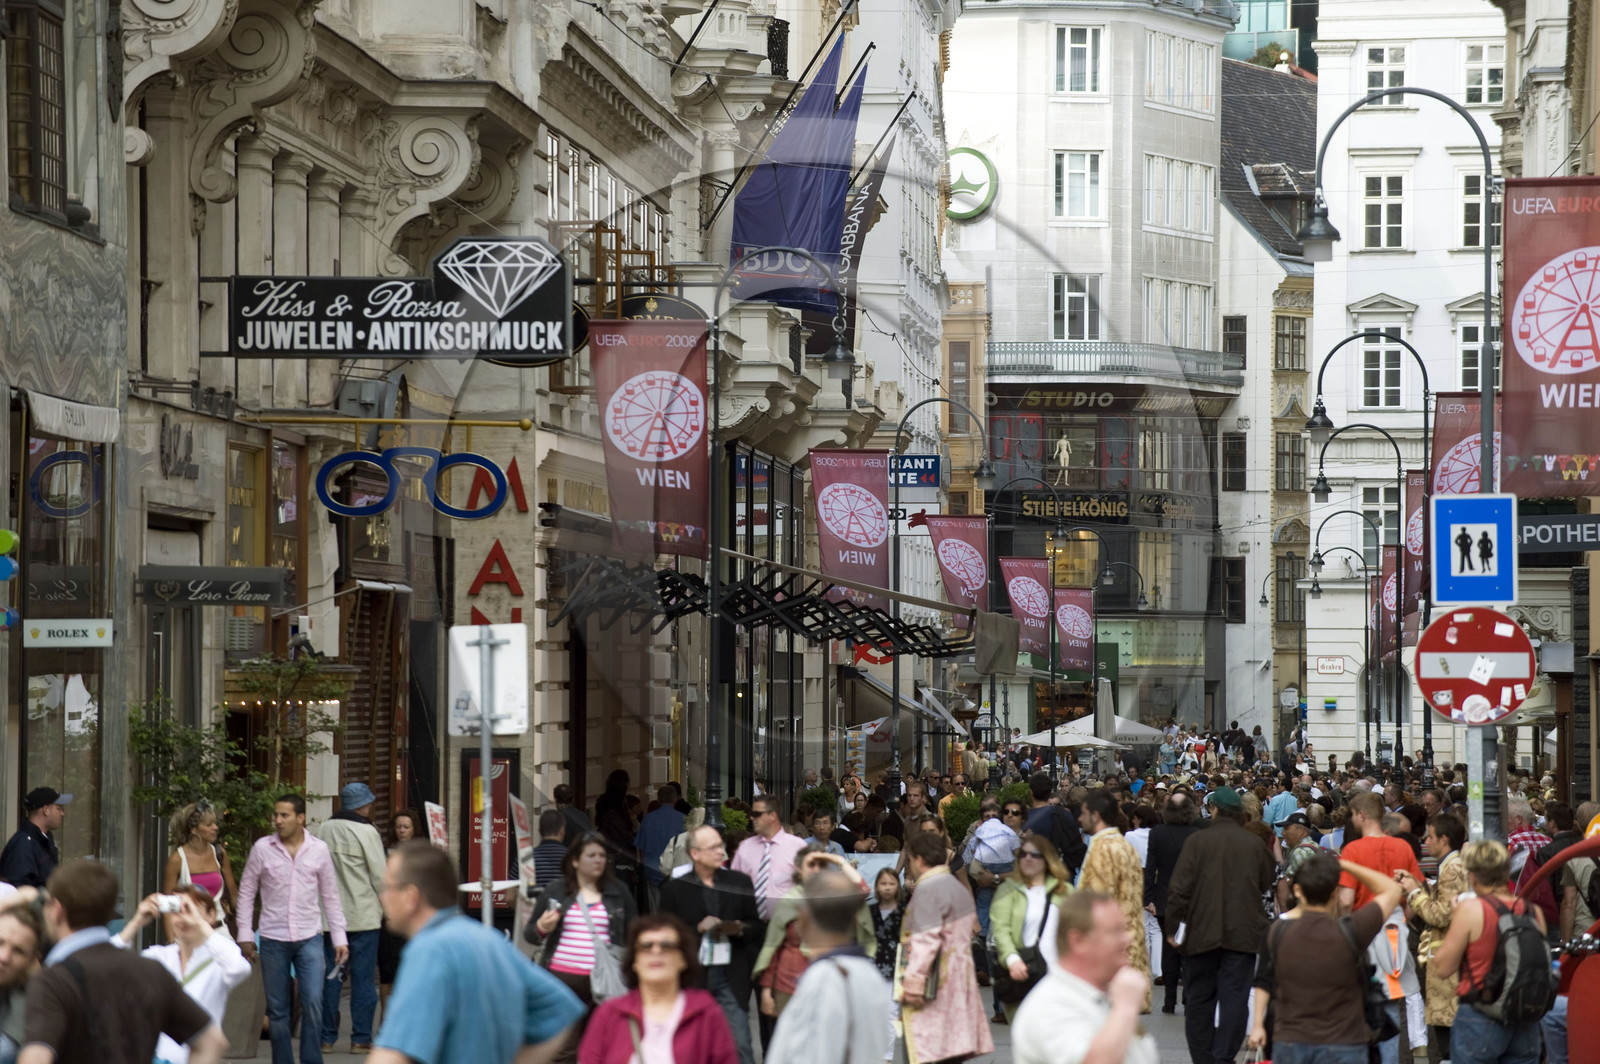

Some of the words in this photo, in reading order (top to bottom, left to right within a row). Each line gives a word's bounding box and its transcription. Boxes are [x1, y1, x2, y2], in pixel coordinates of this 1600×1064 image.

[1512, 197, 1556, 215] UEFA
[838, 182, 873, 275] GABBANA
[743, 247, 812, 273] BDO
[241, 279, 316, 317] Kiss
[325, 294, 352, 317] &
[363, 280, 467, 318] Rozsa
[367, 320, 564, 350] ANTIKSCHMUCK
[595, 334, 628, 347] UEFA
[628, 334, 665, 347] EURO
[665, 334, 697, 348] 2008
[1026, 390, 1114, 407] STUDIO
[1439, 403, 1467, 415] UEFA
[890, 458, 935, 469] RANT
[635, 467, 691, 490] WIEN
[888, 472, 918, 485] NTE
[1522, 523, 1600, 545] POTHE
[188, 580, 222, 601] Loro
[225, 580, 271, 601] Piana
[47, 629, 89, 639] ROLEX
[471, 894, 497, 902] MAZ
